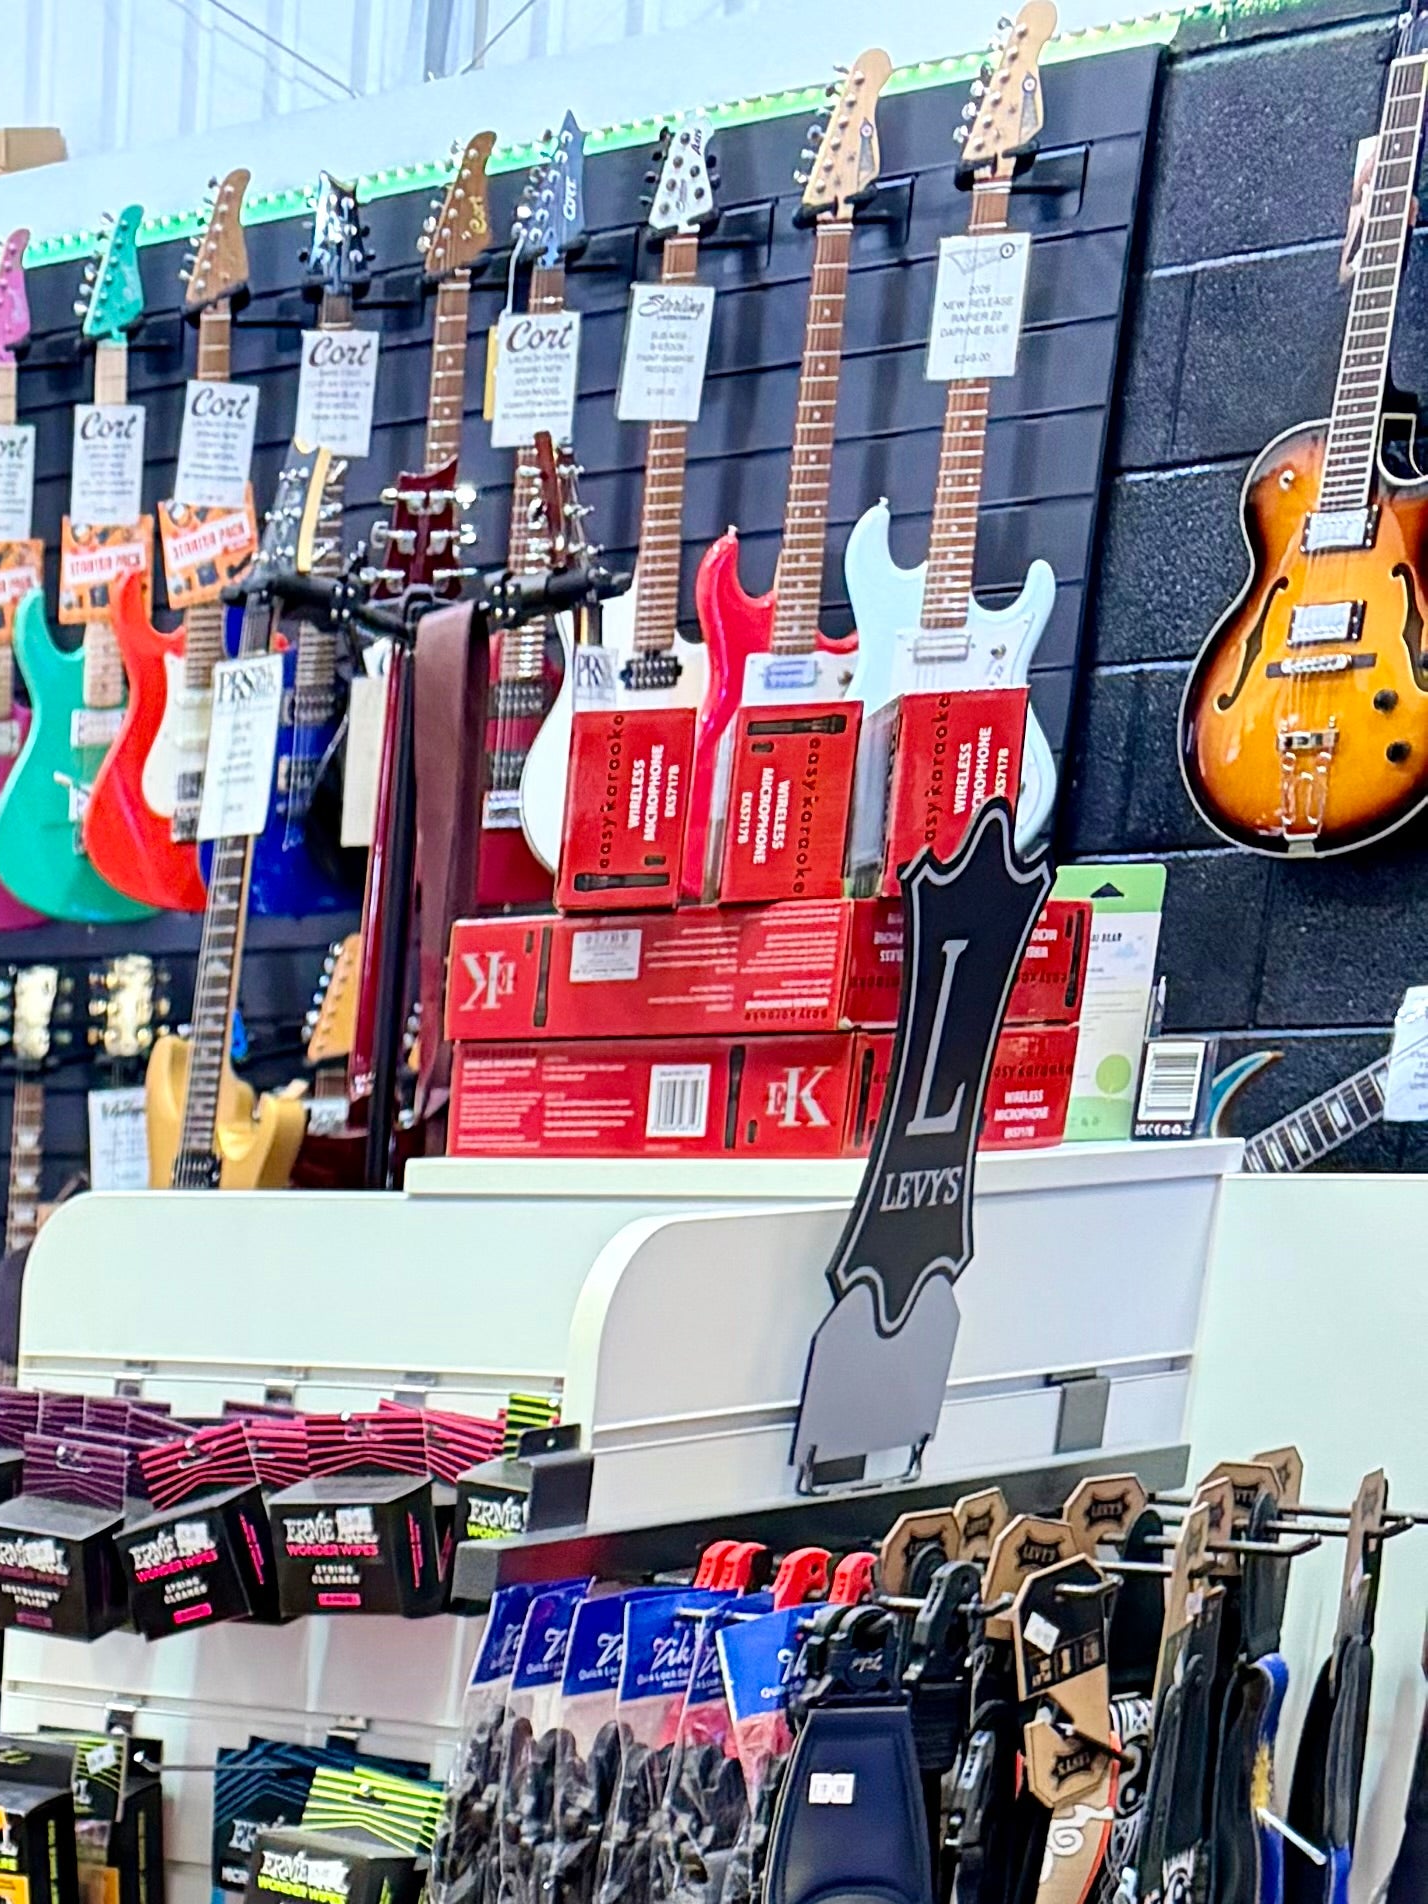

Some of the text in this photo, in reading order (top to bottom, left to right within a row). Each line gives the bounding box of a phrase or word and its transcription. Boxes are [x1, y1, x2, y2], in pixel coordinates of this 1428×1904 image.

[307, 335, 372, 368] Cort
[504, 318, 575, 355] Cort
[191, 387, 251, 420] Cort
[80, 410, 138, 441] Cort
[627, 757, 647, 831] WIRELESS
[643, 742, 665, 843] MICROPHONE
[953, 741, 973, 816] WIRELESS
[752, 766, 776, 866] MICROPHONE
[771, 778, 792, 851] WIRELESS
[905, 939, 970, 1137] L
[765, 1065, 834, 1128] EK
[1003, 1088, 1045, 1105] WIRELESS
[993, 1105, 1049, 1122] MICROPHONE
[879, 1164, 966, 1214] LEVY'S
[282, 1511, 335, 1546] ERNIE
[134, 1549, 219, 1584] WONDER WIPES
[285, 1543, 380, 1559] WONDER WIPES
[164, 1575, 200, 1595] STRING
[311, 1573, 362, 1586] CLEANER
[313, 1563, 356, 1576] STRING
[0, 1582, 62, 1603] INSTRUMENT
[14, 1594, 49, 1609] POLISH
[163, 1583, 208, 1605] CLEANER
[257, 1874, 308, 1900] WONDER
